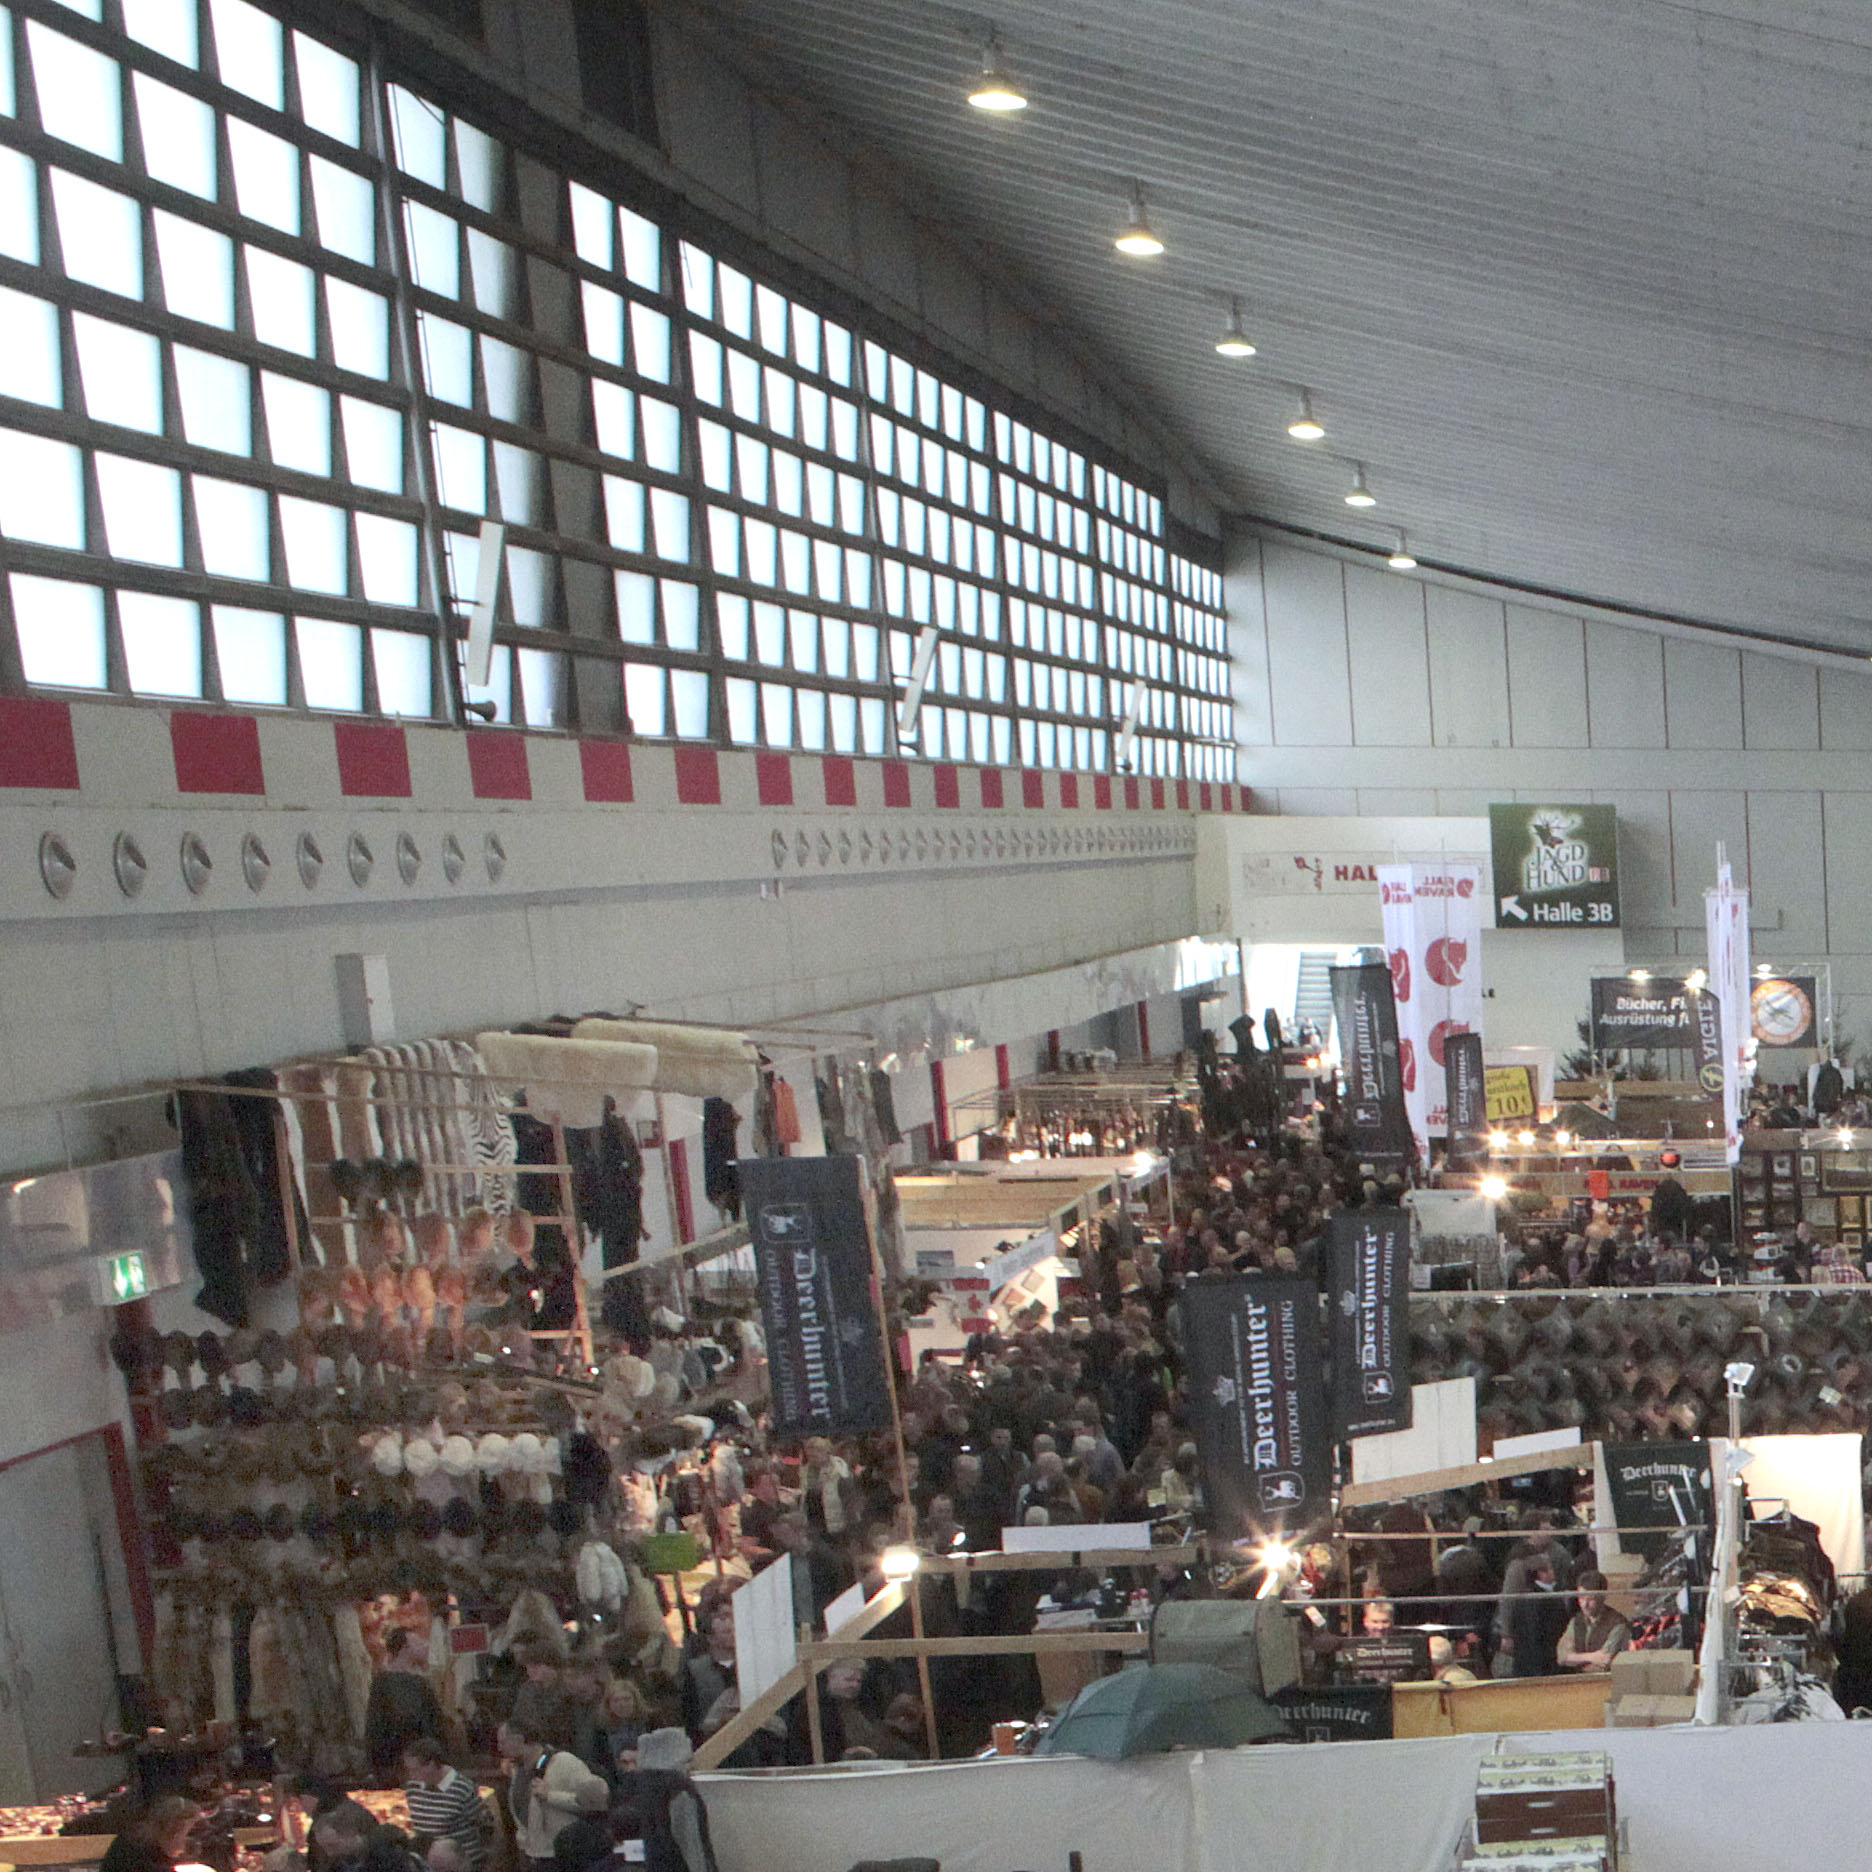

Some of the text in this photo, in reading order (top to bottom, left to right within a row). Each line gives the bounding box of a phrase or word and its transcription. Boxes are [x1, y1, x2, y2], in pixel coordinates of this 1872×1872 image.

[1527, 864, 1586, 891] HUND
[1533, 902, 1614, 922] Halle 3B
[1361, 1232, 1378, 1370] Deerhunter
[1246, 1302, 1278, 1471] Deerhunter
[1280, 1300, 1300, 1467] OUTDOOR CLOTHING
